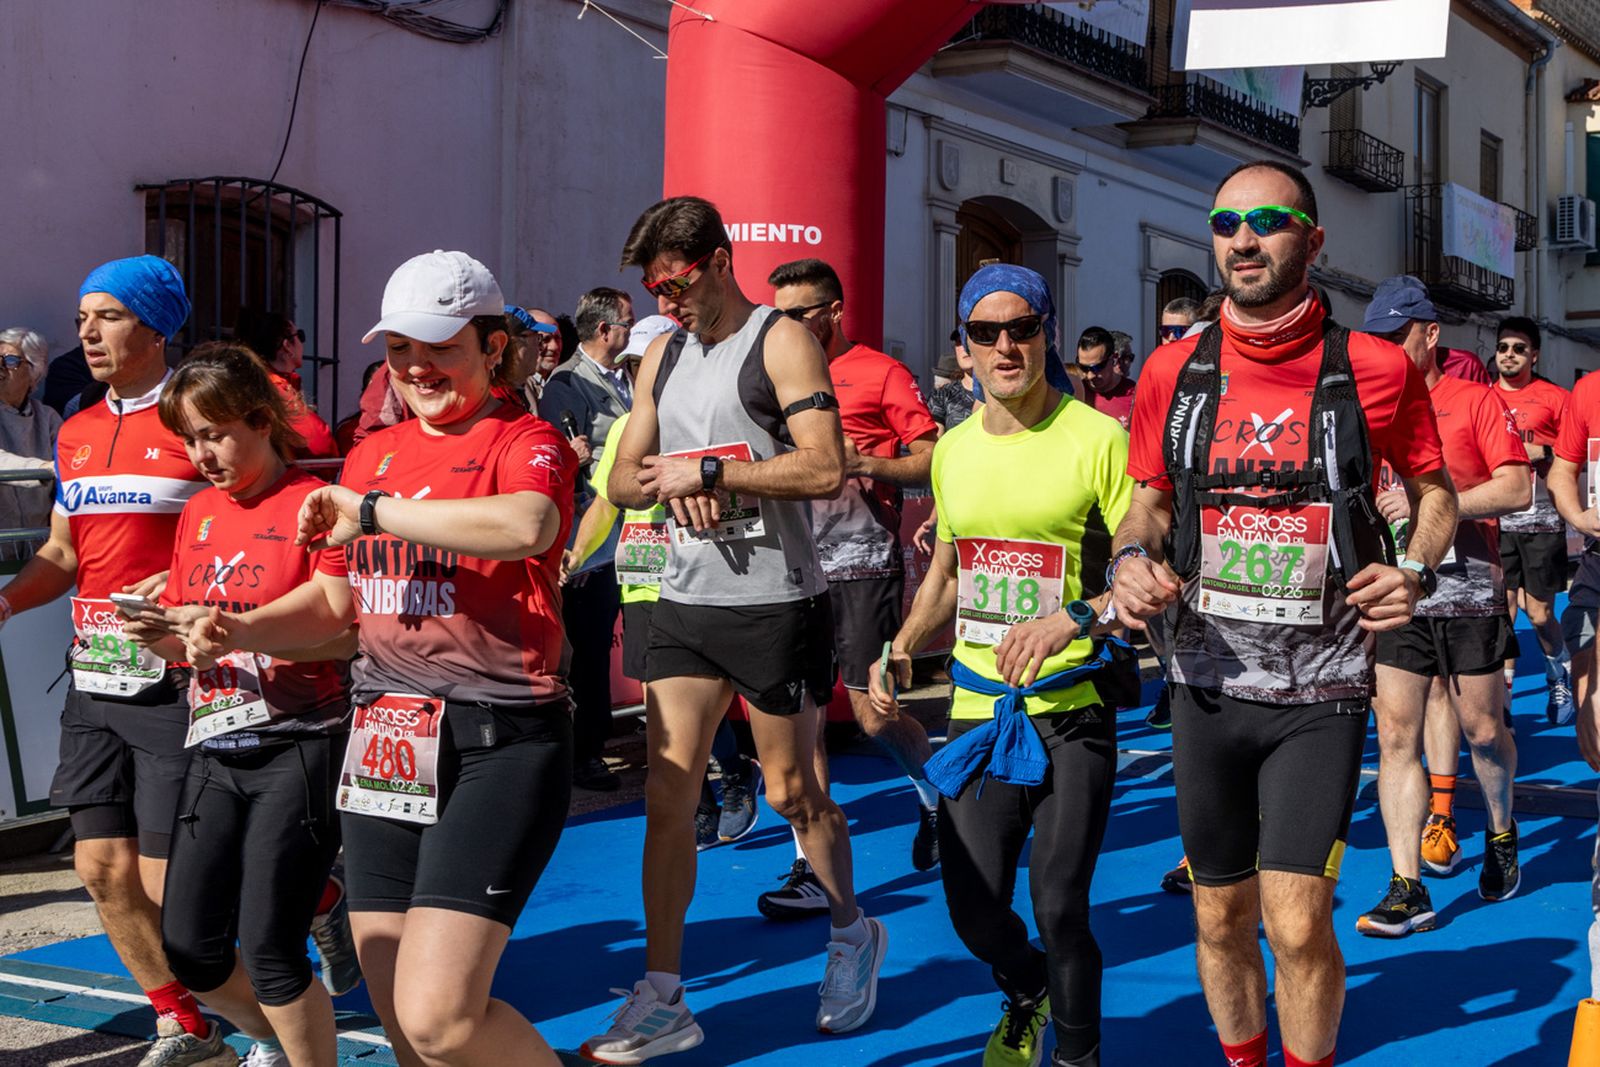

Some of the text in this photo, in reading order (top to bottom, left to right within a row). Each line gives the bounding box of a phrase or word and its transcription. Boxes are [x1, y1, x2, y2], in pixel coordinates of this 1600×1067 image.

[1212, 419, 1308, 446] CROS
[84, 486, 152, 505] Avanza
[1217, 505, 1237, 528] X
[1239, 513, 1308, 534] CROSS
[1217, 526, 1291, 547] PANTANO
[972, 541, 988, 563] X
[988, 549, 1044, 569] CROSS
[1218, 539, 1305, 586] 267
[187, 562, 266, 589] CROSS
[972, 561, 1029, 580] PANTANO
[972, 573, 1040, 616] 318
[81, 603, 125, 624] X CRO
[374, 706, 420, 727] CROSS
[361, 733, 417, 781] 480
